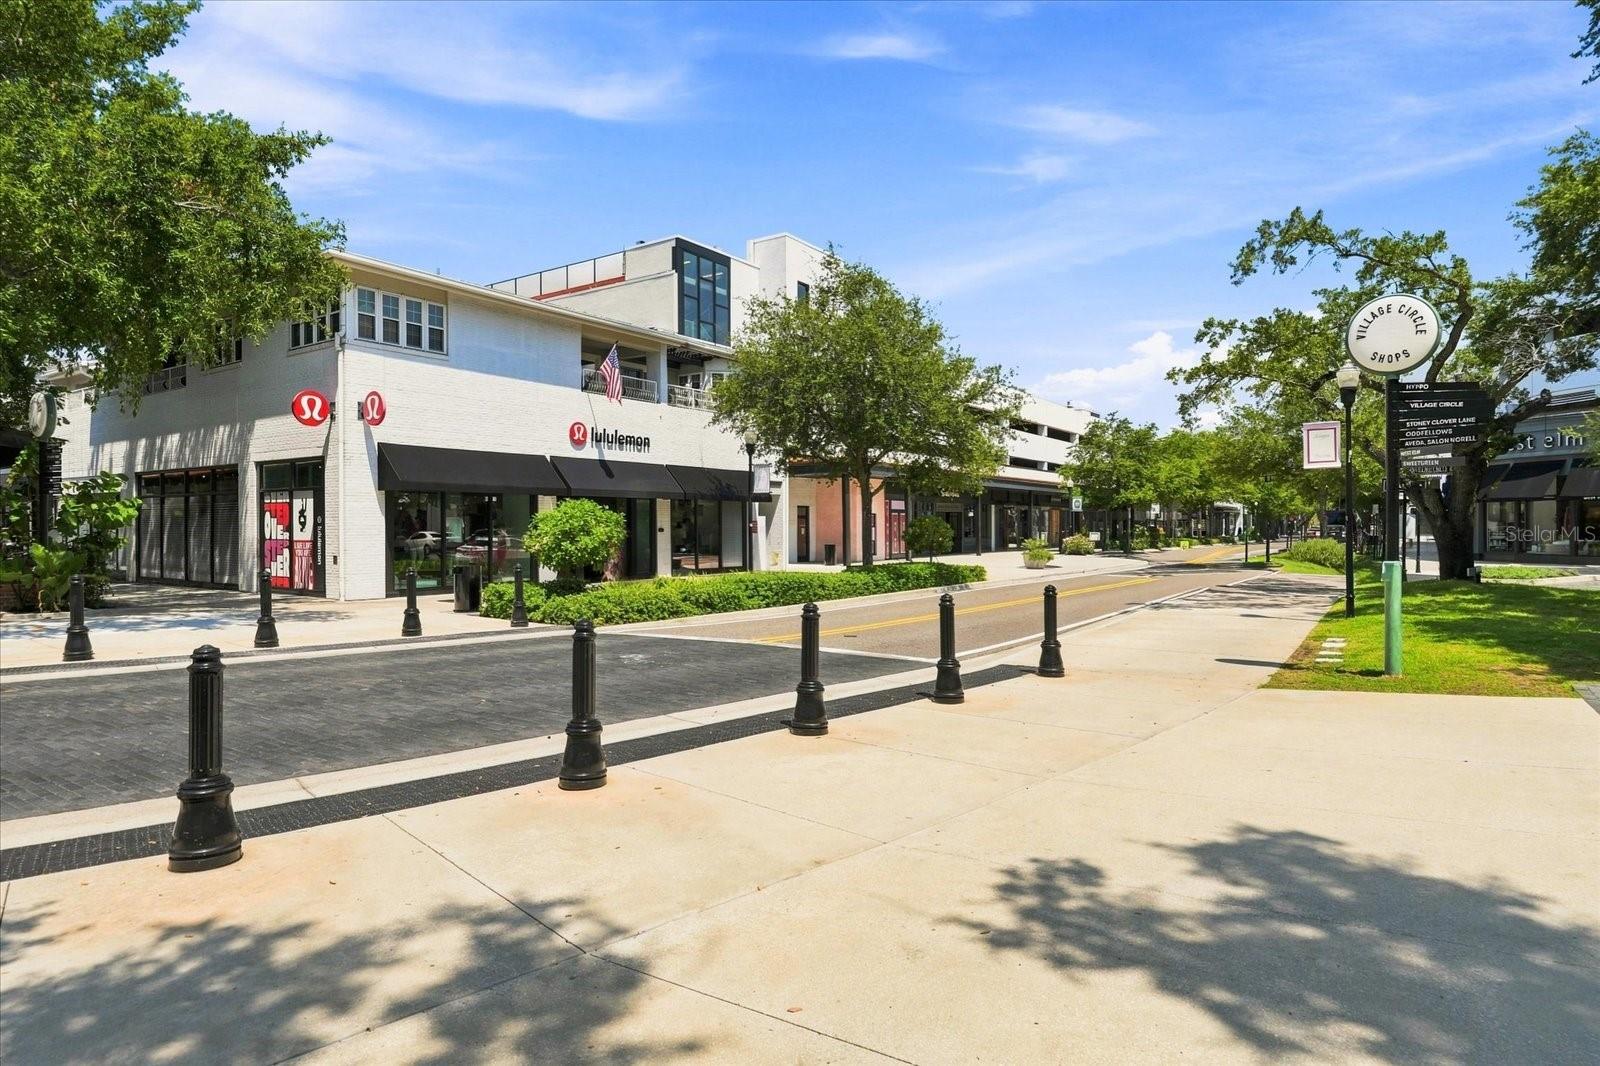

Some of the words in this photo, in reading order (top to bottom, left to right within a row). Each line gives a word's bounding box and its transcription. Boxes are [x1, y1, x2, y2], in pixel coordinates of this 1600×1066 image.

[1356, 304, 1392, 340] VILLAGE
[1398, 304, 1426, 335] CIRCLE
[1370, 349, 1410, 363] SHOPS
[591, 427, 650, 447] lululemon
[1405, 429, 1453, 437] ODDFELLOWS
[1543, 432, 1583, 448] elm
